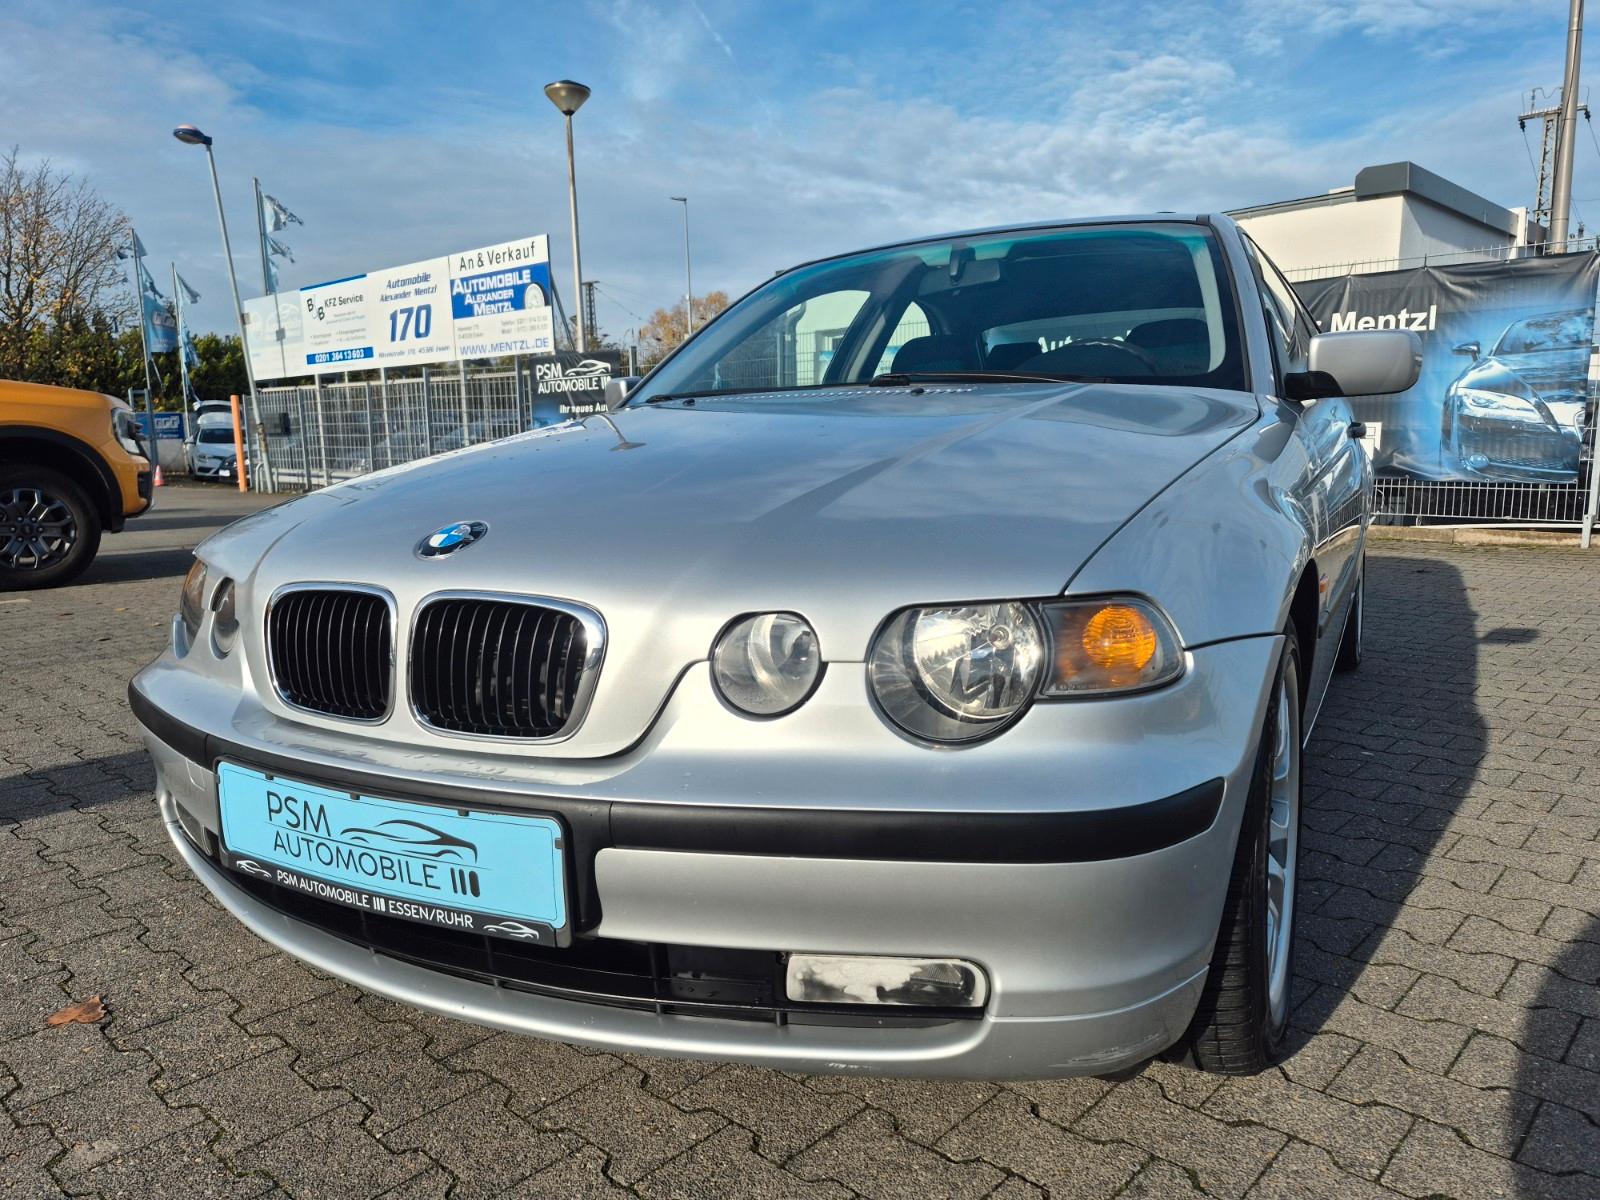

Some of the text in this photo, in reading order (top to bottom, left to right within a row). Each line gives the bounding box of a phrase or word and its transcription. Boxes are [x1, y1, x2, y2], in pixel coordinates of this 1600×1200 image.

[460, 241, 535, 271] An & Verkauf
[386, 272, 431, 289] Automobile
[452, 269, 532, 297] AUTOMOBILE
[324, 297, 337, 307] KFZ
[338, 294, 364, 306] Service
[464, 289, 514, 305] ALEXANDER
[474, 301, 515, 316] MENTZL
[389, 303, 432, 343] 170
[1330, 304, 1437, 333] Mentzl
[460, 337, 549, 356] WWW.MENTZL.DE
[536, 363, 562, 381] PSM
[537, 376, 599, 394] AUTOMOBILE
[560, 404, 569, 413] Ihr
[571, 404, 593, 413] neues
[266, 790, 332, 838] PSM
[273, 830, 441, 890] AUTOMOBILE
[276, 869, 475, 929] PSM AUTOMOBILE ESSEN/RUHR
